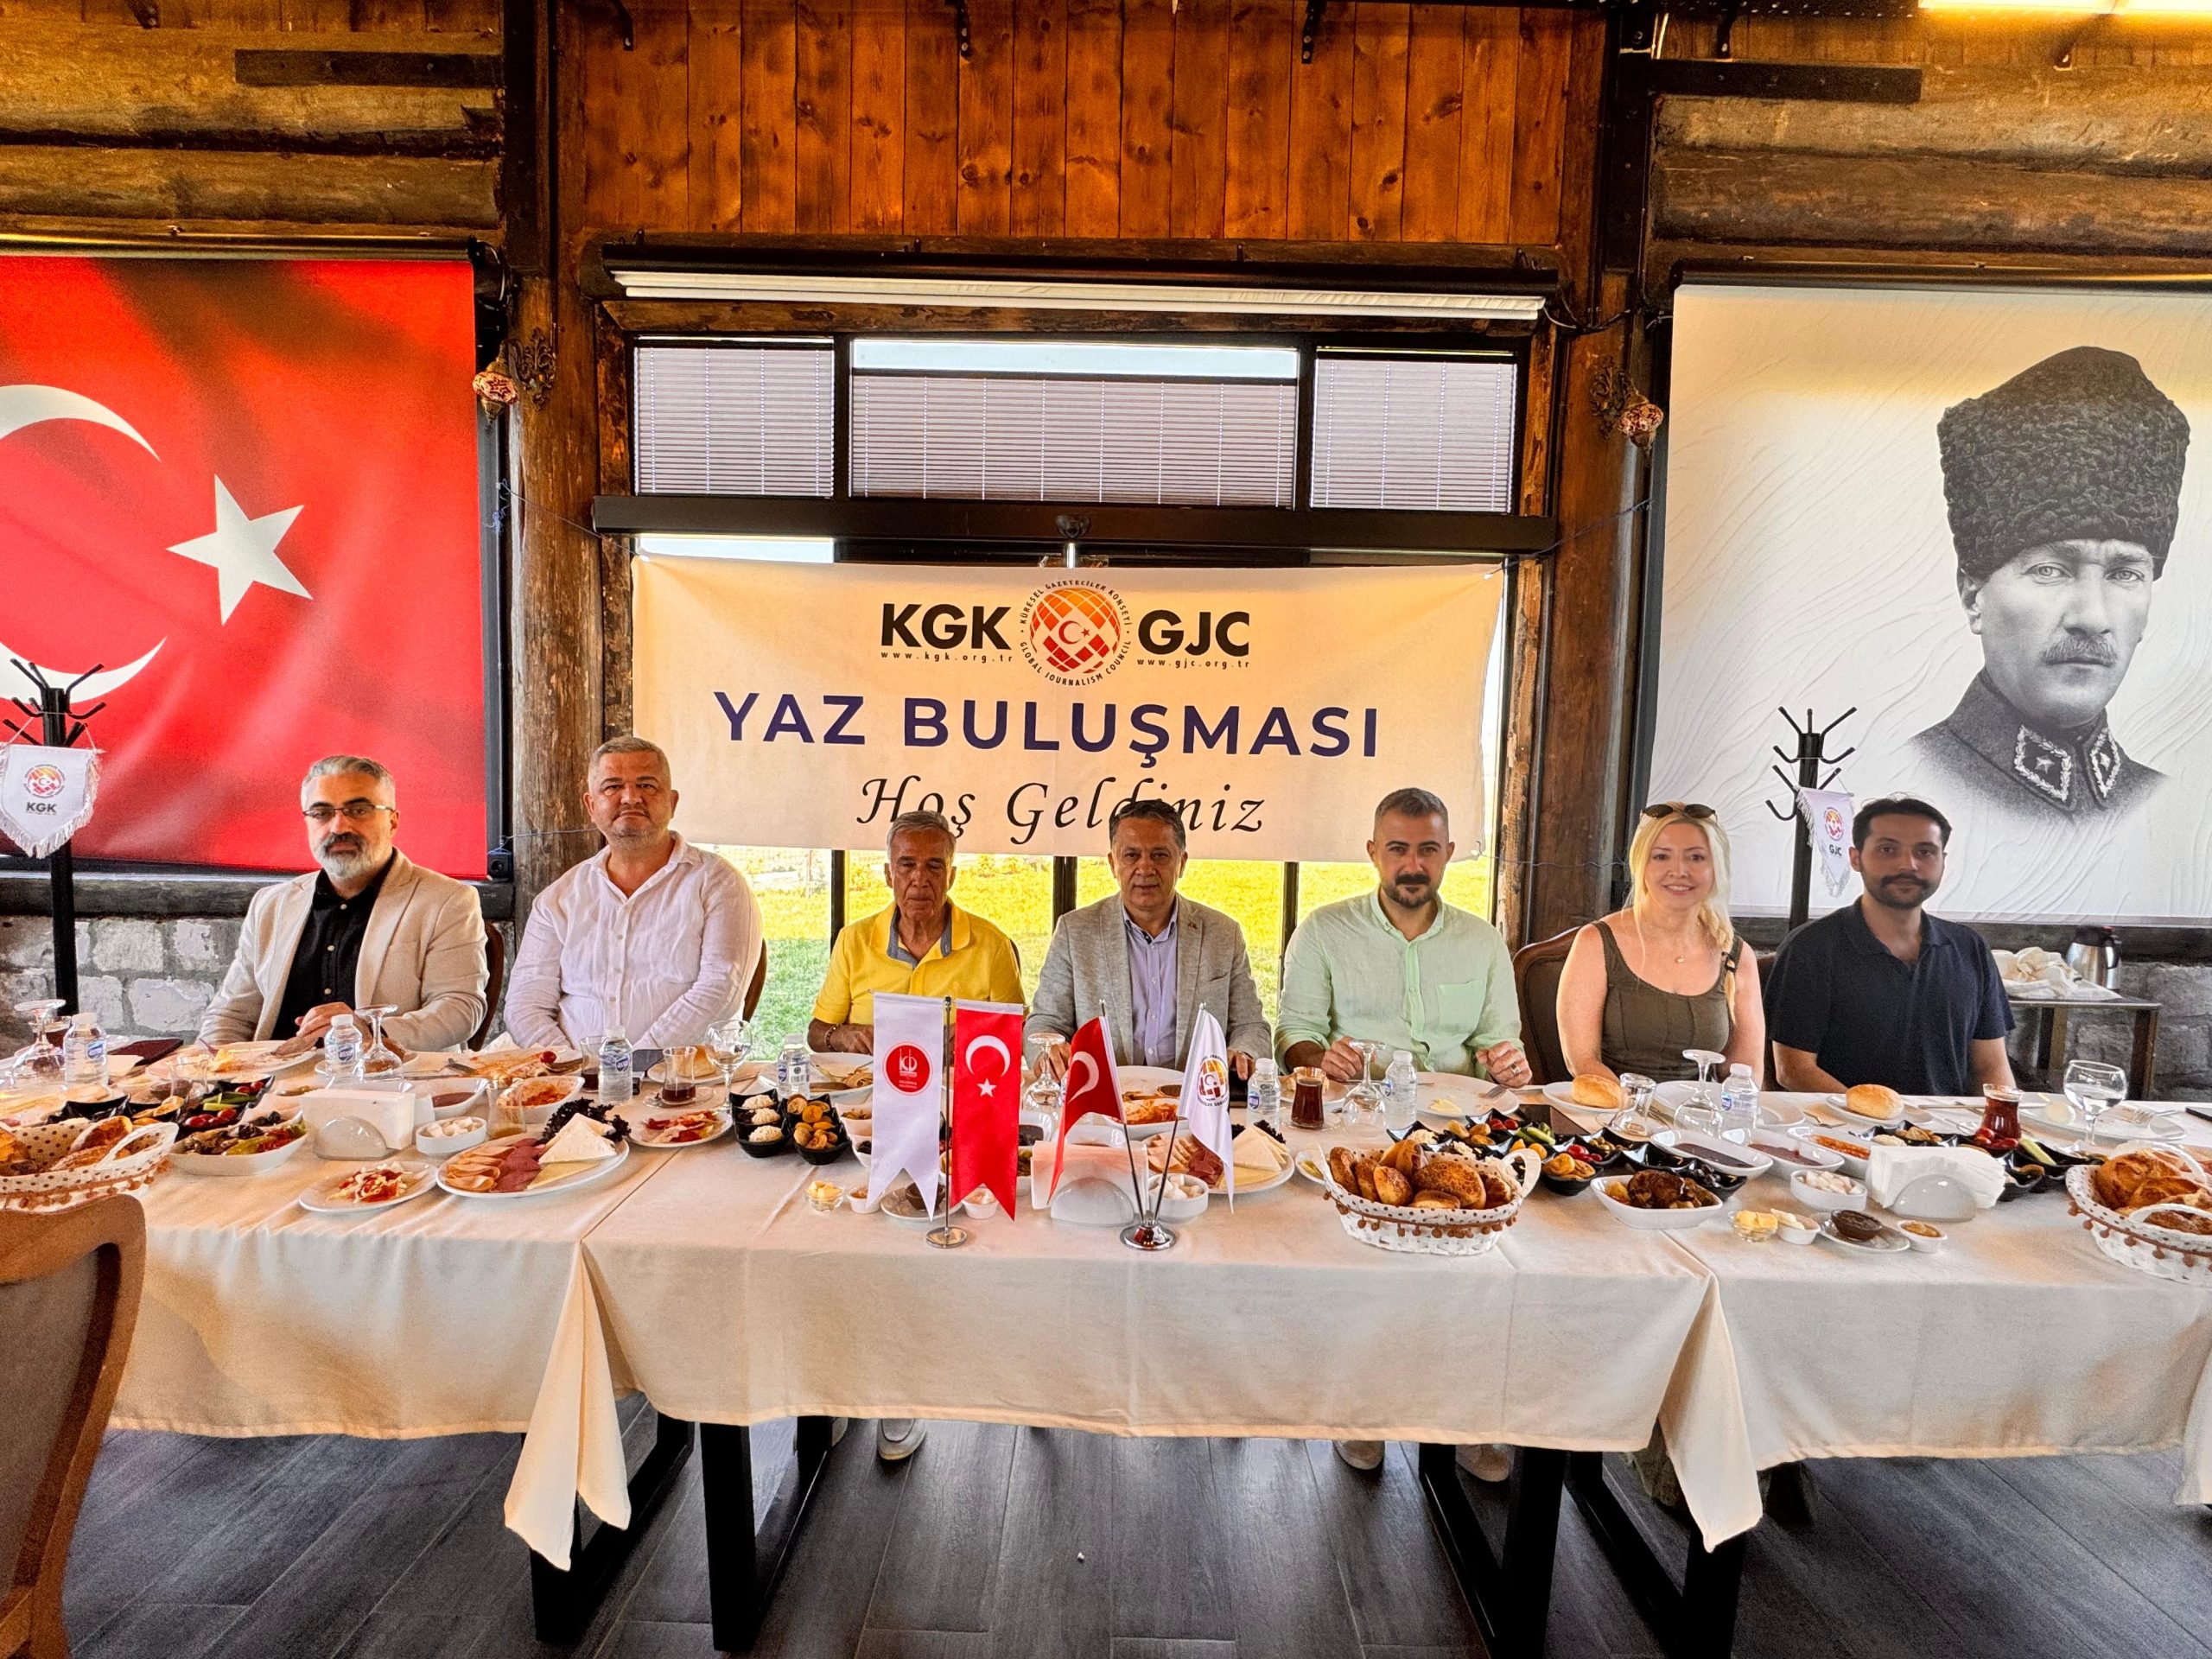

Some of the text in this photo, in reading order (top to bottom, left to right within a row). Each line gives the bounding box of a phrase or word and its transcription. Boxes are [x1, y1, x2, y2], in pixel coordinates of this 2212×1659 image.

[1020, 580, 1133, 626] KÜRESEL GAZETECİLER KONSEYİ
[881, 603, 1012, 650] KGK
[1138, 609, 1249, 658] GJC
[880, 652, 1013, 664] www.kgk.org.tr
[1020, 640, 1131, 686] GLOBAL JOURNALISM COUNCIL
[1137, 658, 1249, 670] www.gjc.org.tr
[713, 691, 1378, 768] YAZ BULUŞMASI
[26, 802, 57, 812] KGK
[856, 775, 976, 839] Hoş
